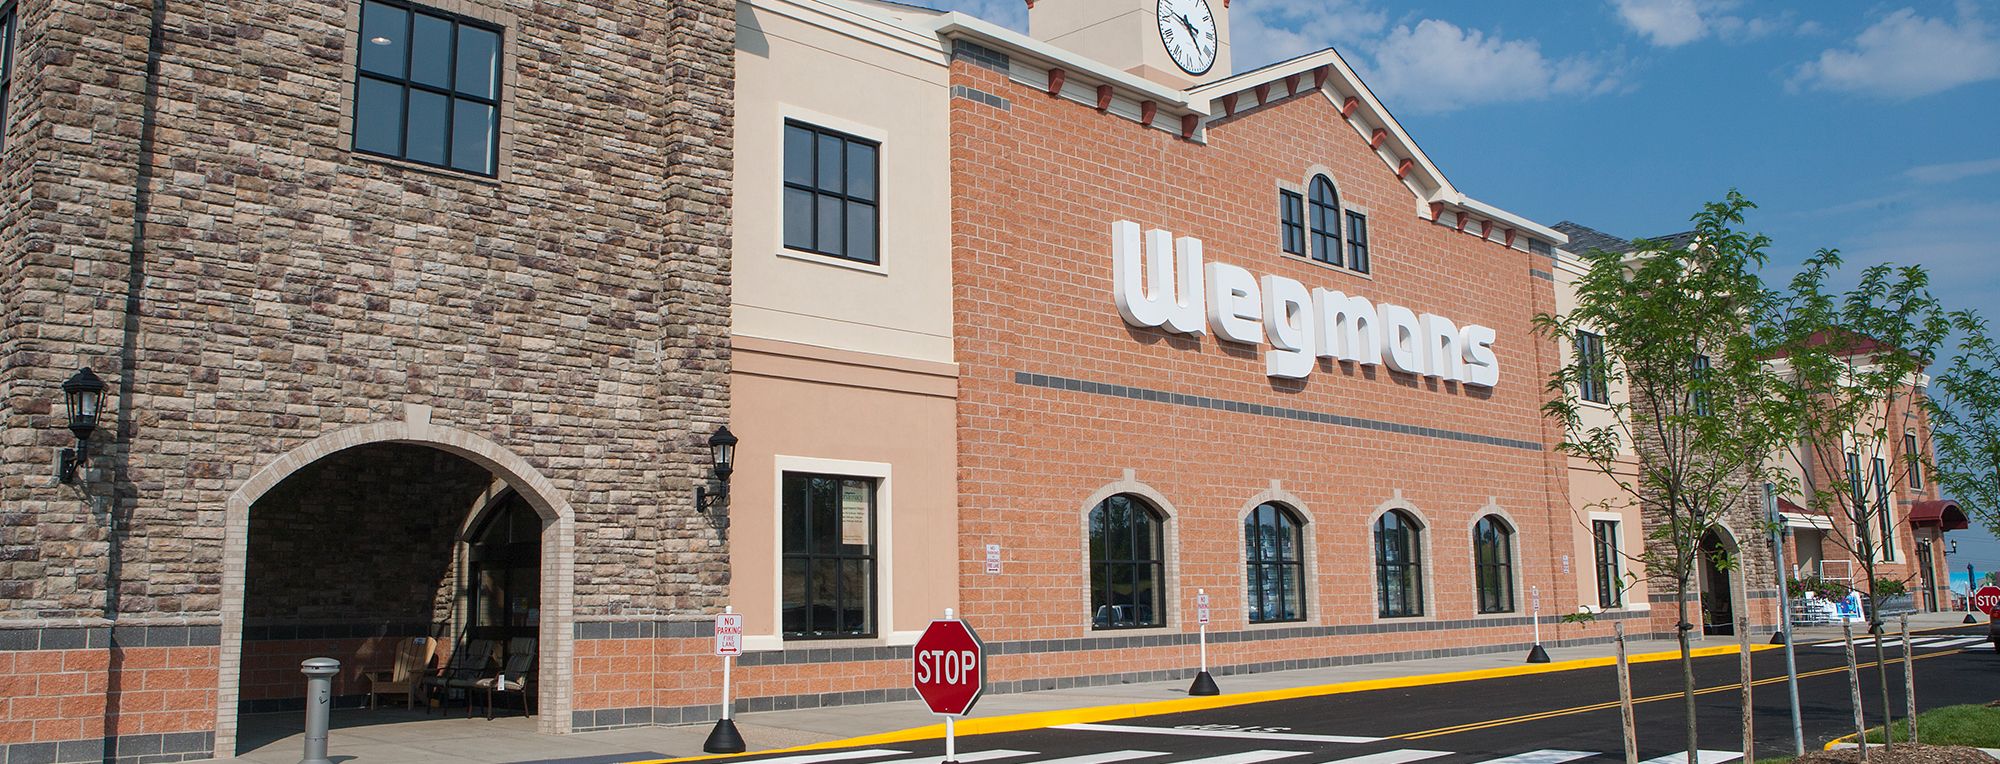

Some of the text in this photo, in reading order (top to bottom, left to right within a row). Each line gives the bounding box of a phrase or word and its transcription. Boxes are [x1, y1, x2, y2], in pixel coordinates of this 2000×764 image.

[1112, 219, 1499, 388] Wegmans
[1978, 595, 2000, 606] STO
[724, 617, 734, 625] NO
[717, 626, 741, 634] PARKING
[917, 649, 976, 685] STOP
